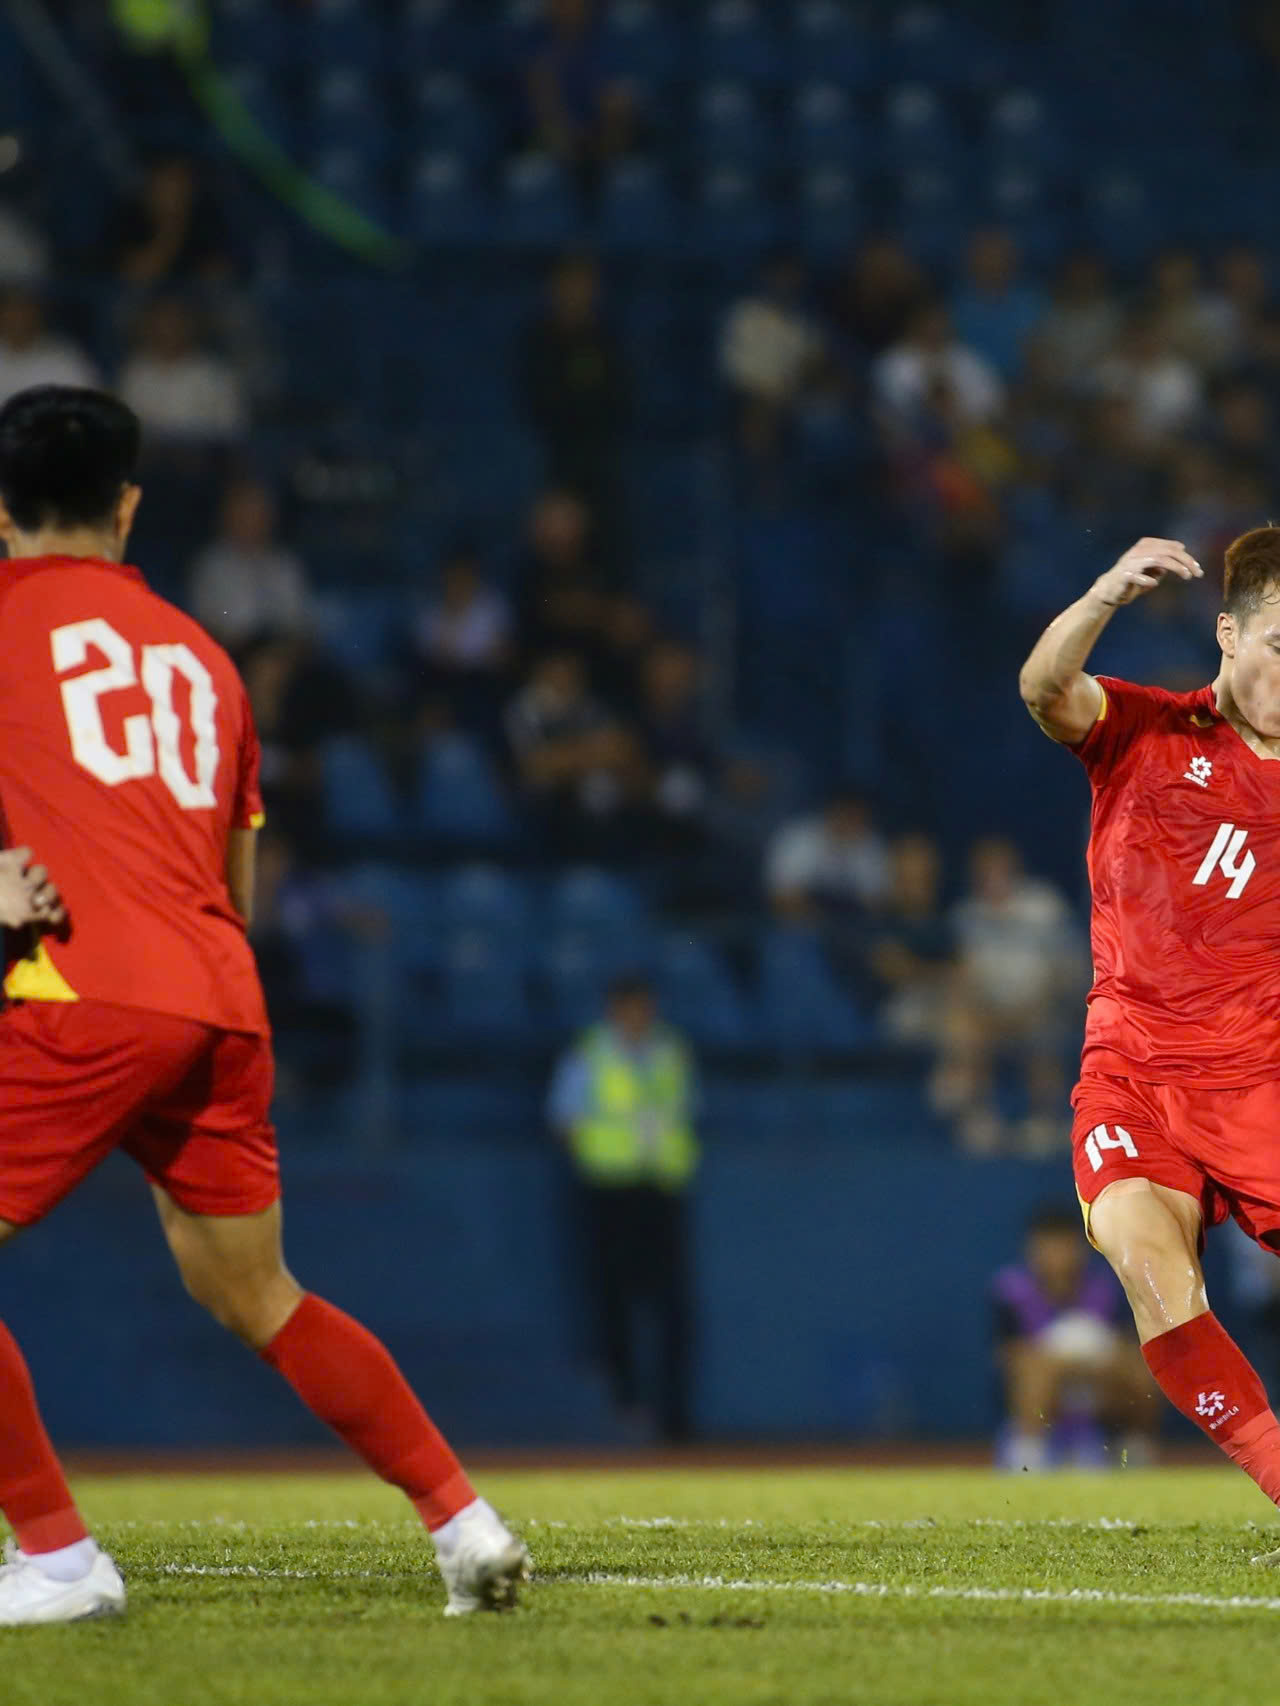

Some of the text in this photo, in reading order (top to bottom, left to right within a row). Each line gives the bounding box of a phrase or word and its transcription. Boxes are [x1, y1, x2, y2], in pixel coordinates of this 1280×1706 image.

[51, 618, 219, 809] 20
[1192, 823, 1256, 899] 14
[1085, 1123, 1139, 1173] 14
